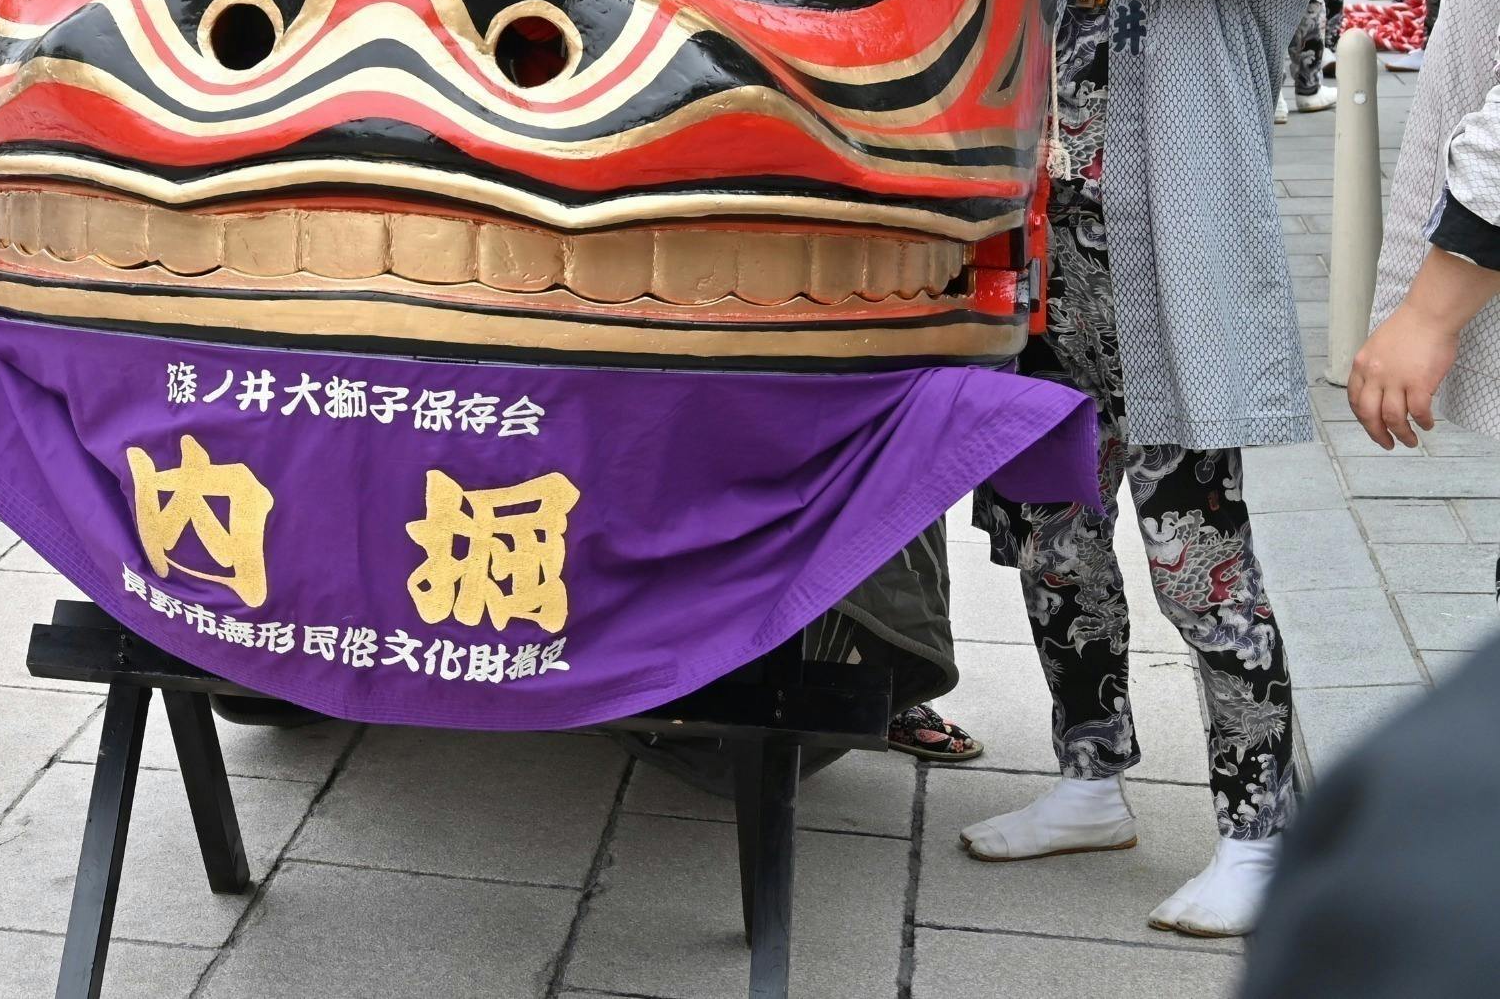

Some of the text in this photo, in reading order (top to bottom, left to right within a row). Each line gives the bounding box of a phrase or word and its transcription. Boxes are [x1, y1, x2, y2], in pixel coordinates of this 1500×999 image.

[166, 362, 546, 438] 篠ノ井大獅子保存会
[121, 561, 570, 684] 長野市無形民俗文化財指定
